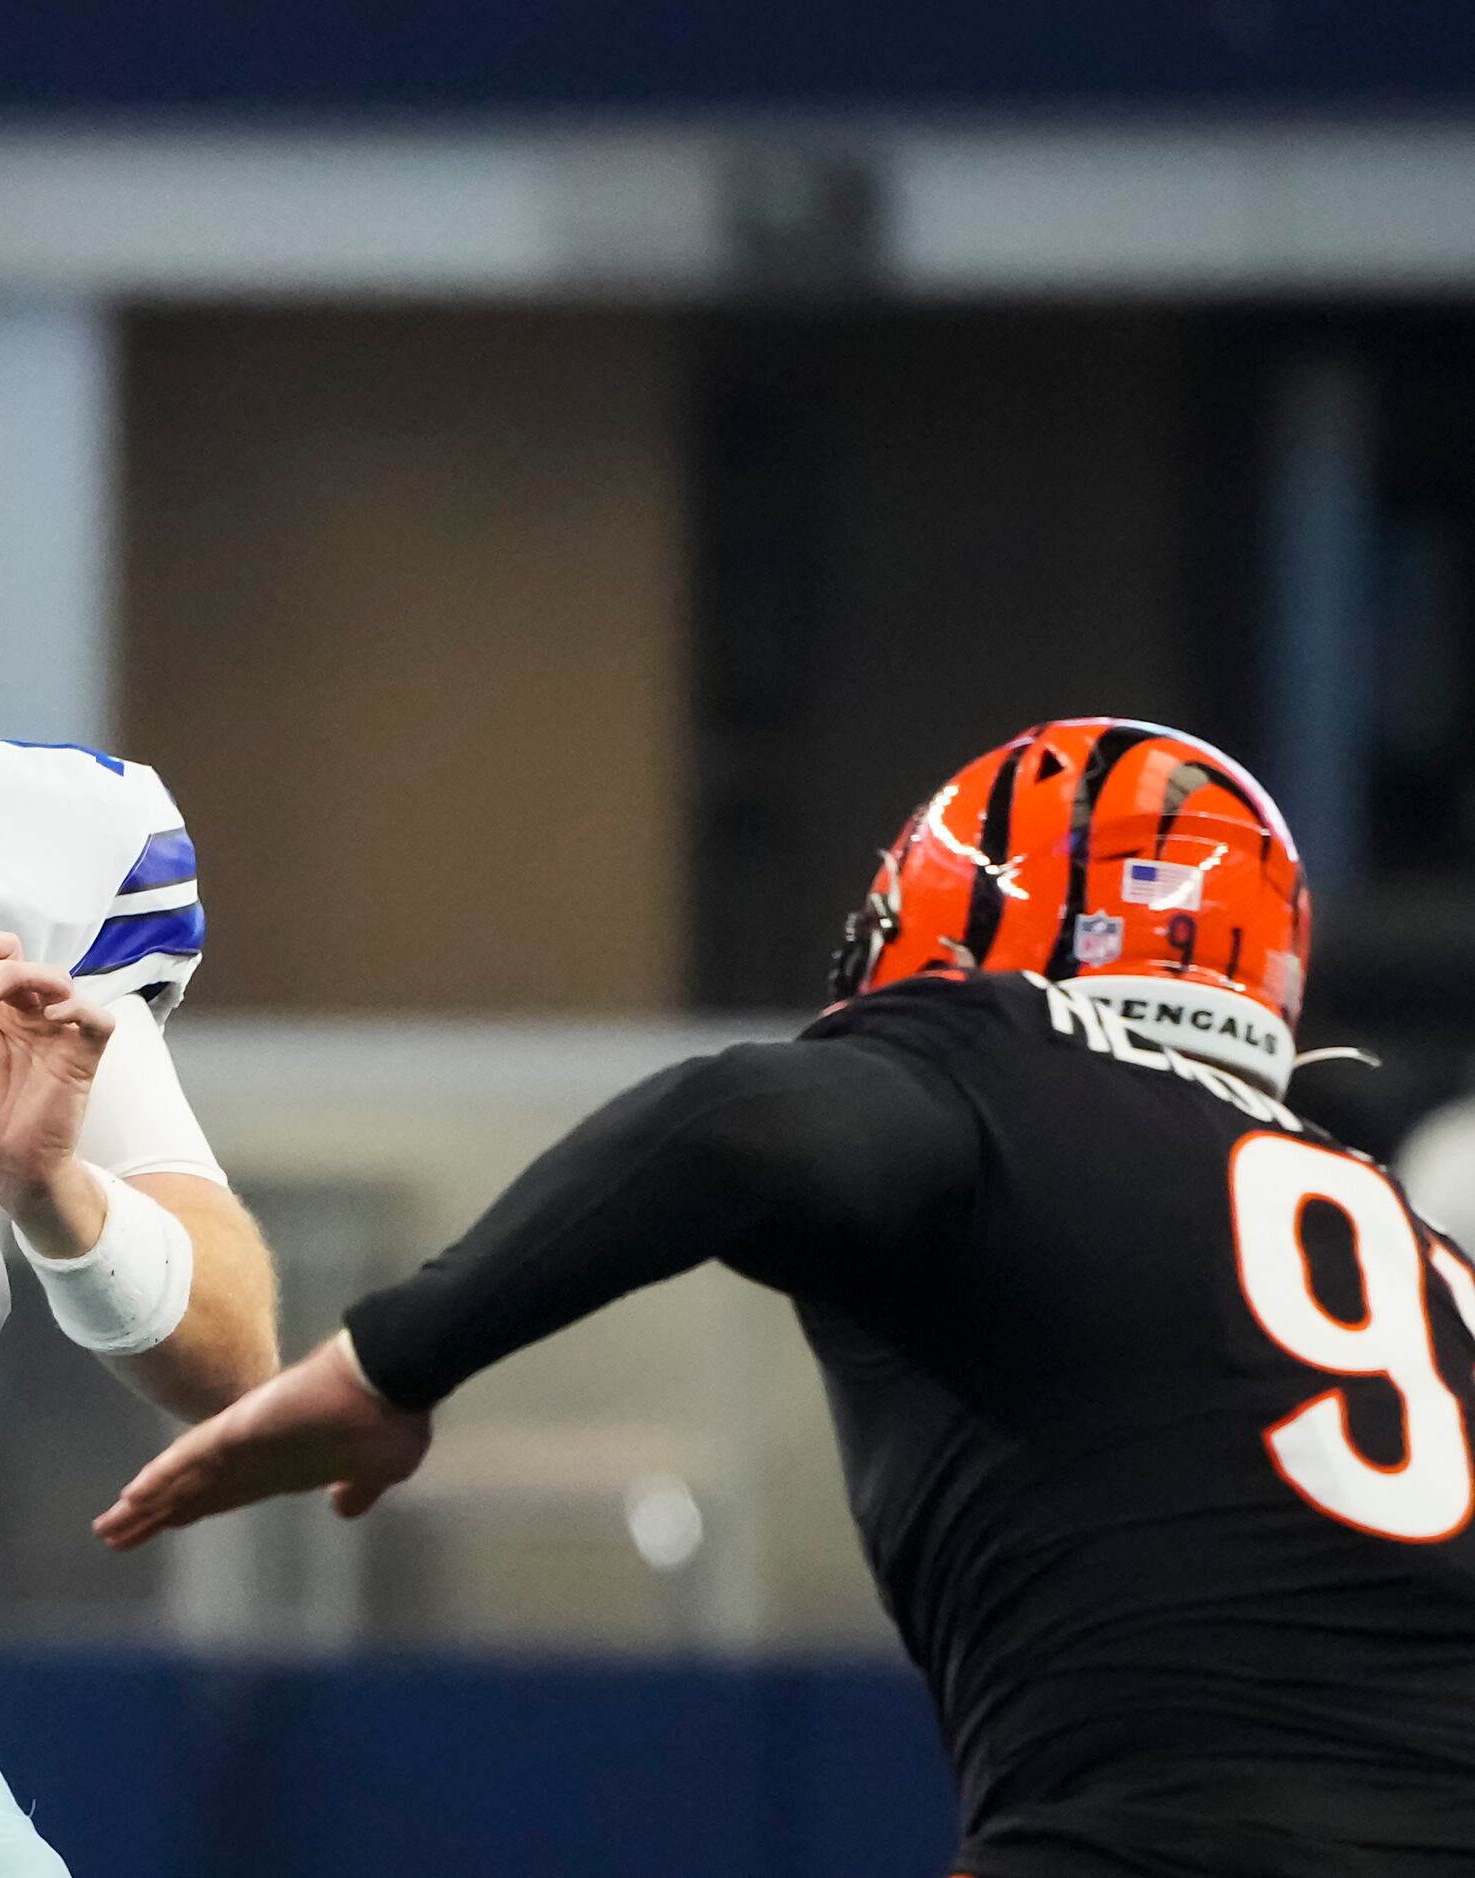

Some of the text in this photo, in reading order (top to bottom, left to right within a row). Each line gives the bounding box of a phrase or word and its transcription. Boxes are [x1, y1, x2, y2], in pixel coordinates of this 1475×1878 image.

[1165, 912, 1243, 981] 91
[1088, 996, 1277, 1056] ENGALS
[1228, 1131, 1475, 1544] 9
